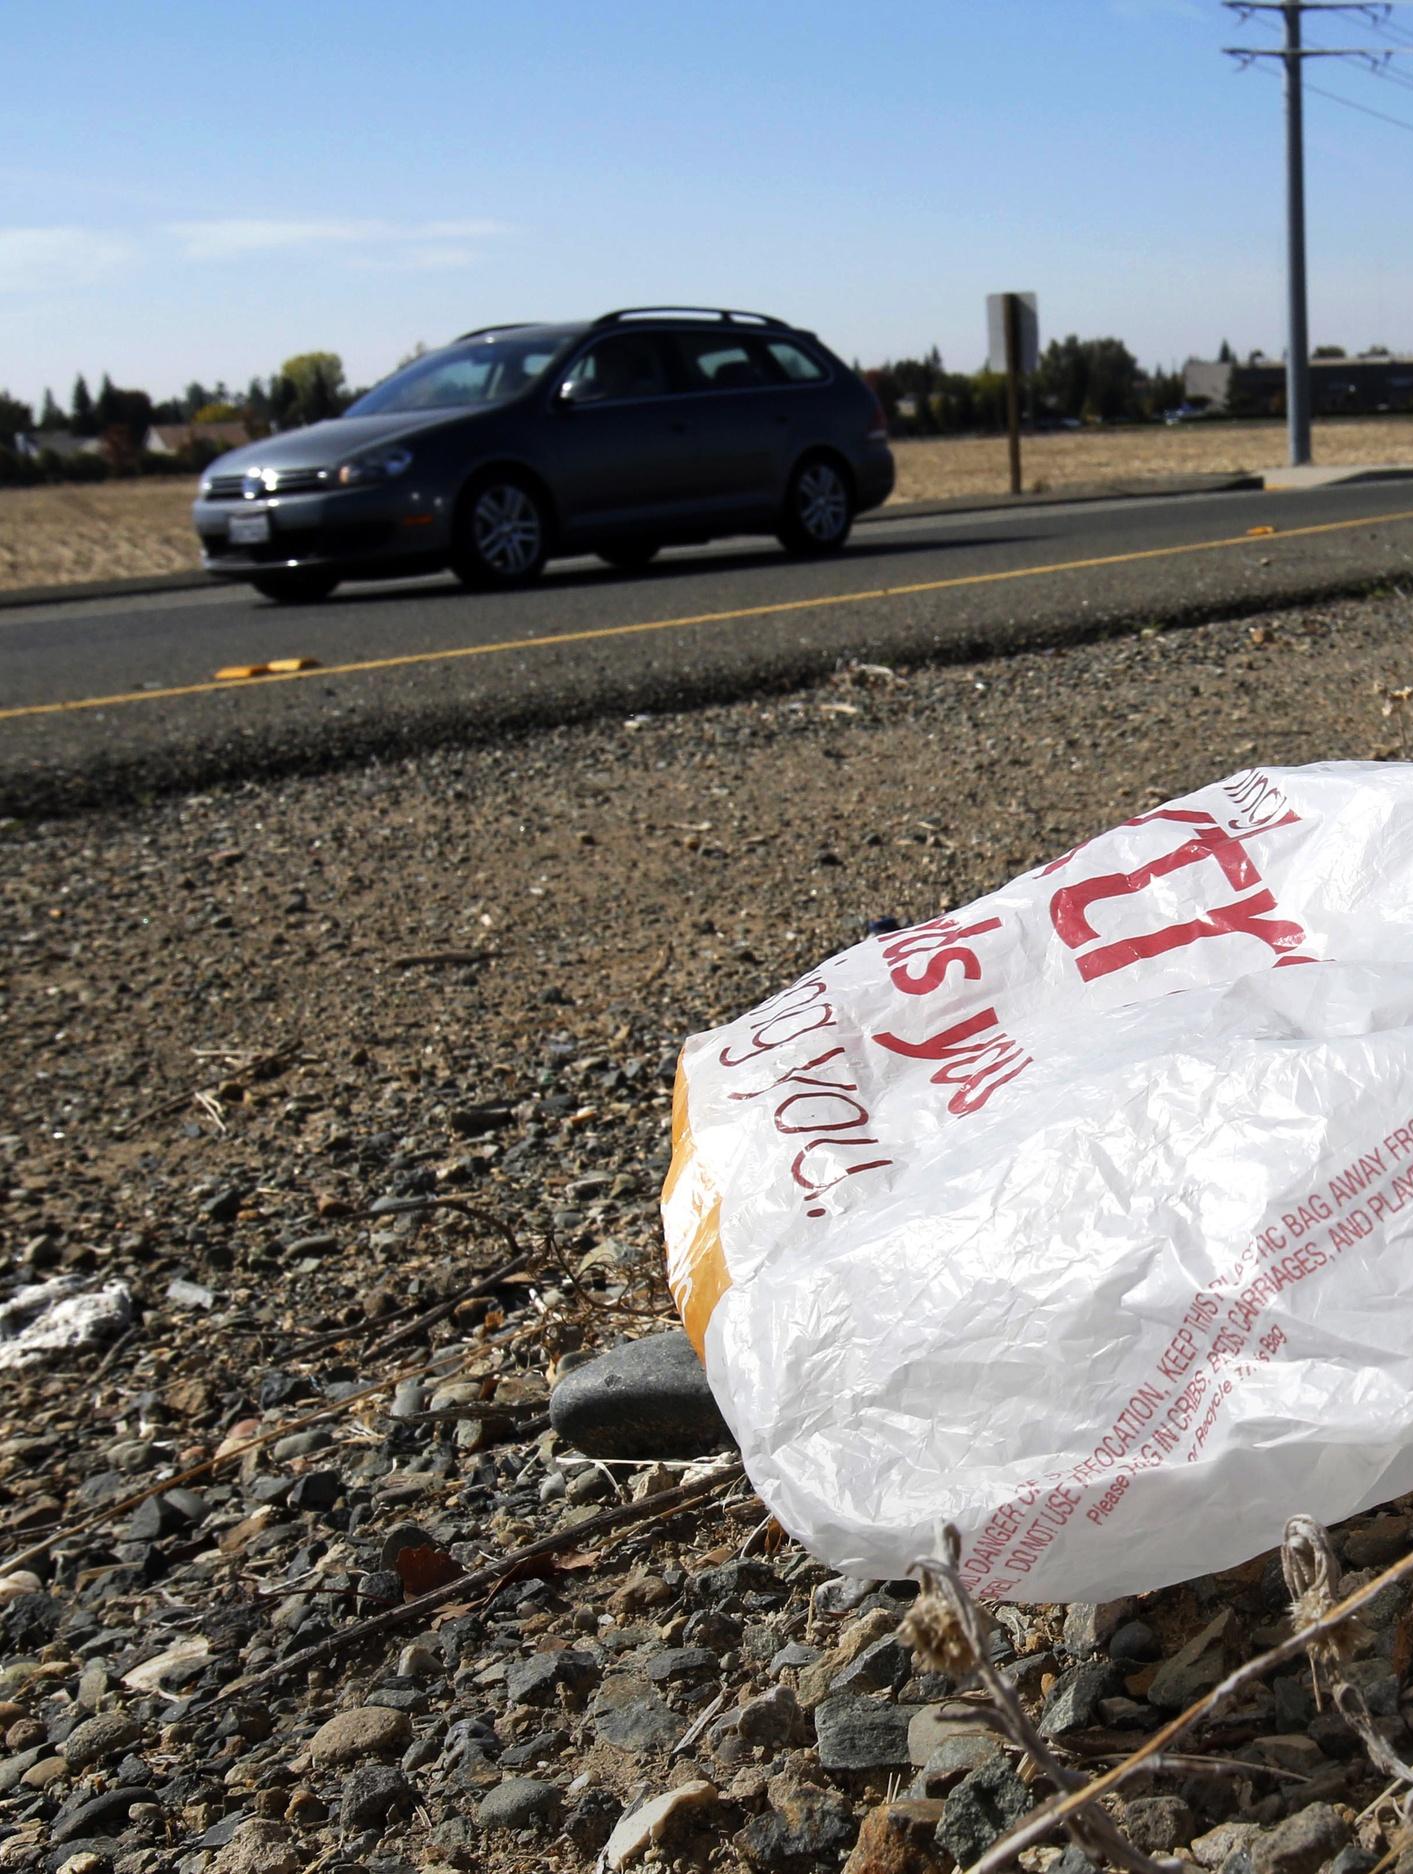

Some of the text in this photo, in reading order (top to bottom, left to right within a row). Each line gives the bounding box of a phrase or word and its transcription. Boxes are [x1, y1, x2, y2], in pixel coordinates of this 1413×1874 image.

[872, 1007, 1034, 1119] you
[727, 1047, 893, 1217] you.
[1327, 1209, 1374, 1253] AND
[1227, 1241, 1336, 1333] CARRIAGES,
[964, 1500, 1026, 1576] DANGER
[1044, 1382, 1171, 1482] SFFOCATION,
[1157, 1327, 1199, 1383] KEEP
[1184, 1292, 1220, 1335] THIS
[1281, 1194, 1333, 1238] BAG
[1328, 1147, 1389, 1207] AWAY
[1195, 1379, 1233, 1448] Recycle
[1259, 1324, 1288, 1355] Bag
[1151, 1421, 1180, 1454] IN
[1049, 1482, 1081, 1527] USE
[1086, 1473, 1130, 1526] Please
[1004, 1546, 1038, 1573] DO
[1019, 1518, 1056, 1554] NOT
